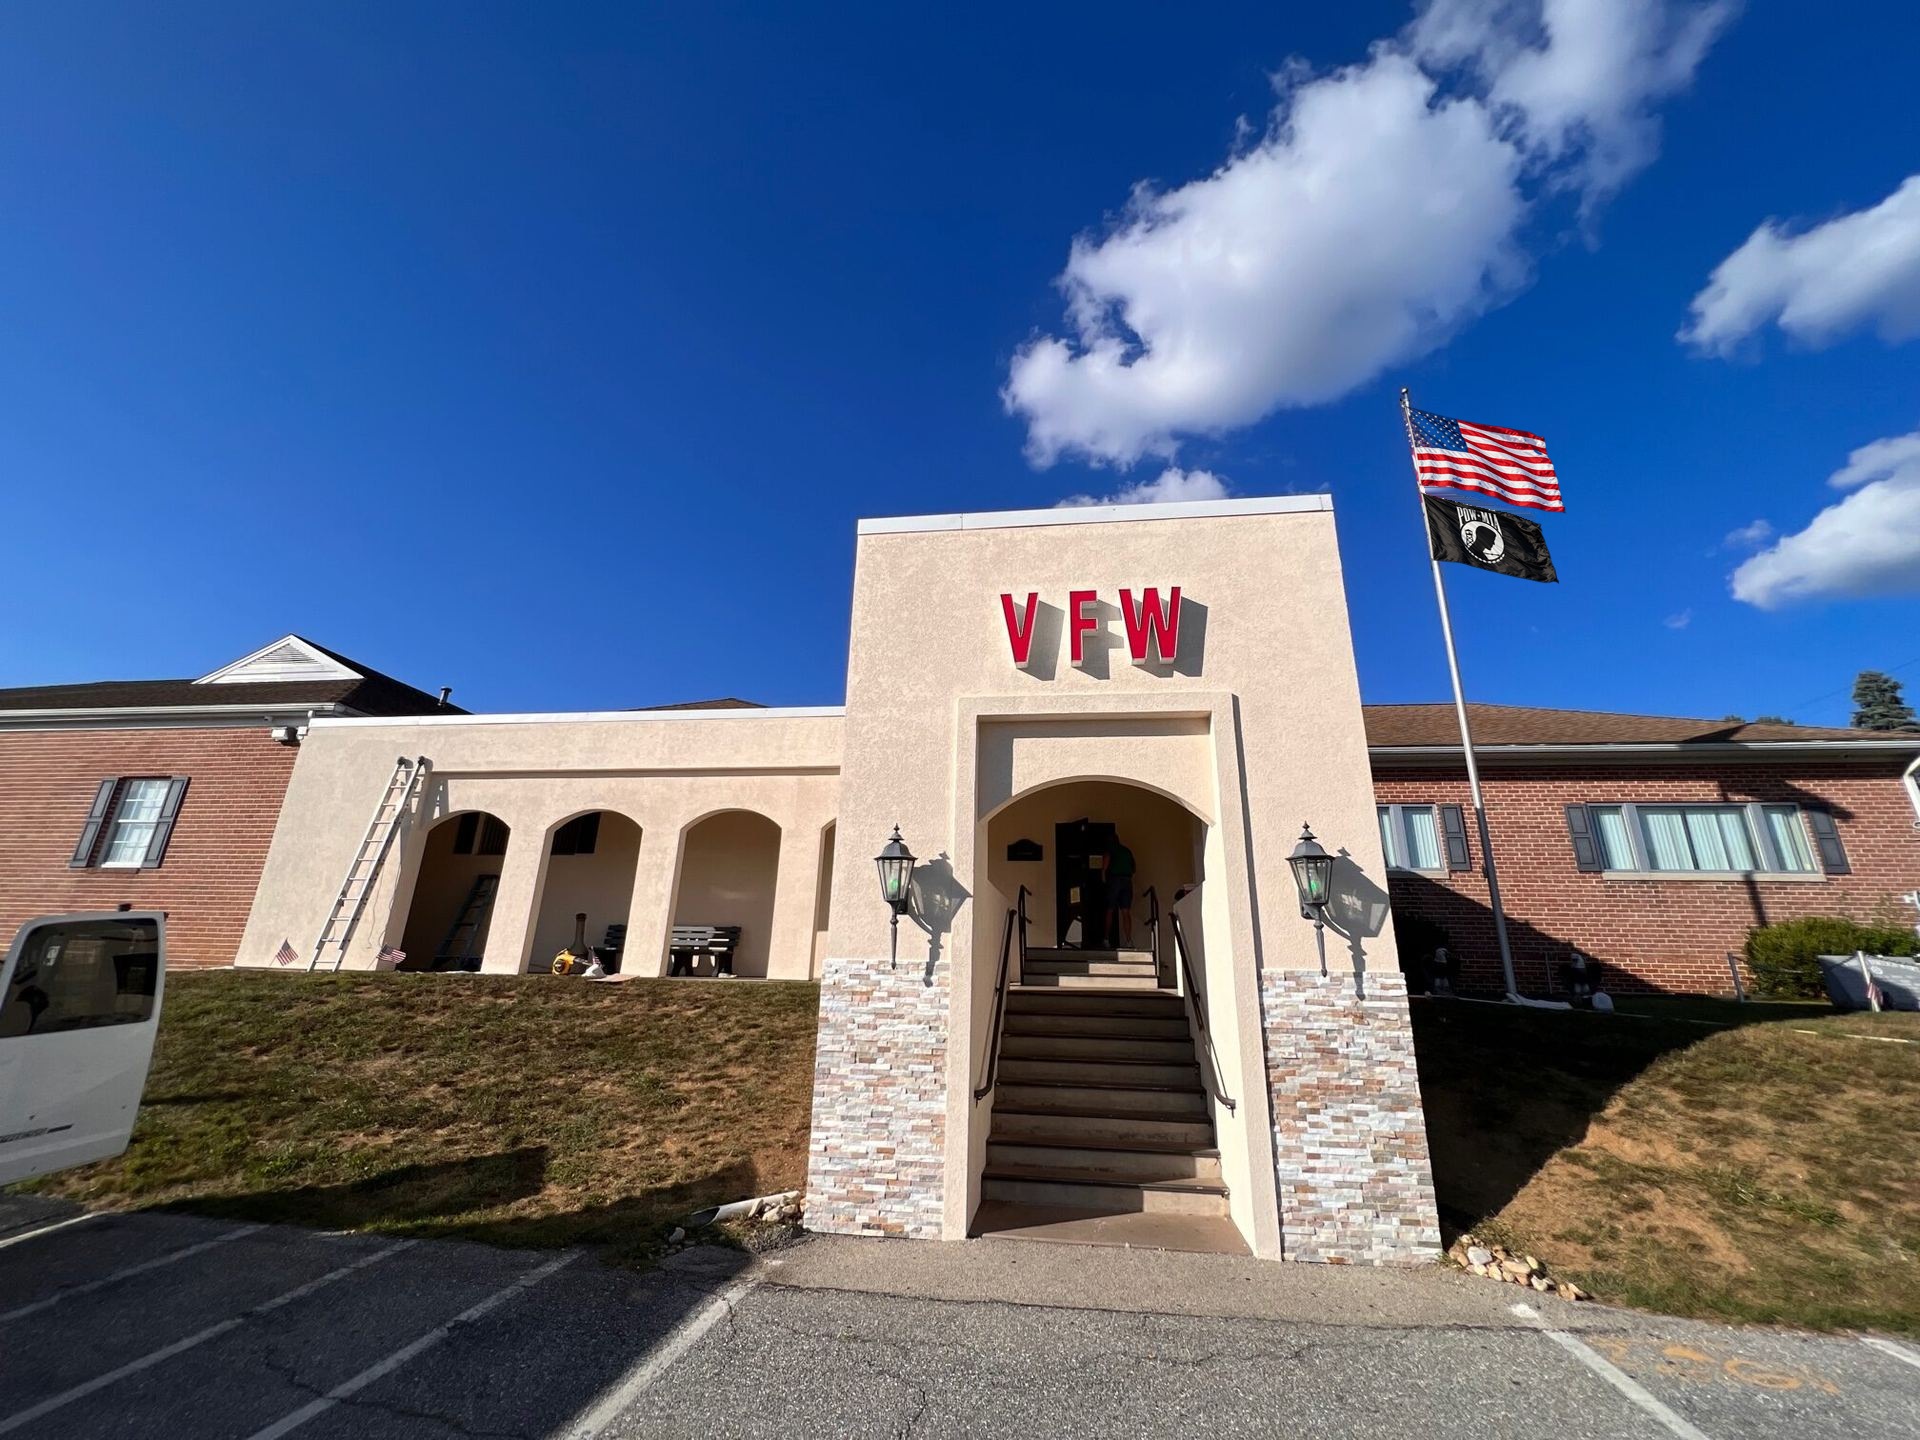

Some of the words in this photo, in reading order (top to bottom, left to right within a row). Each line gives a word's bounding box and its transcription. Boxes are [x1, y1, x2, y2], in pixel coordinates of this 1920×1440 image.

[1456, 506, 1477, 529] POW
[1481, 511, 1502, 534] MIA
[1000, 586, 1181, 666] VFW
